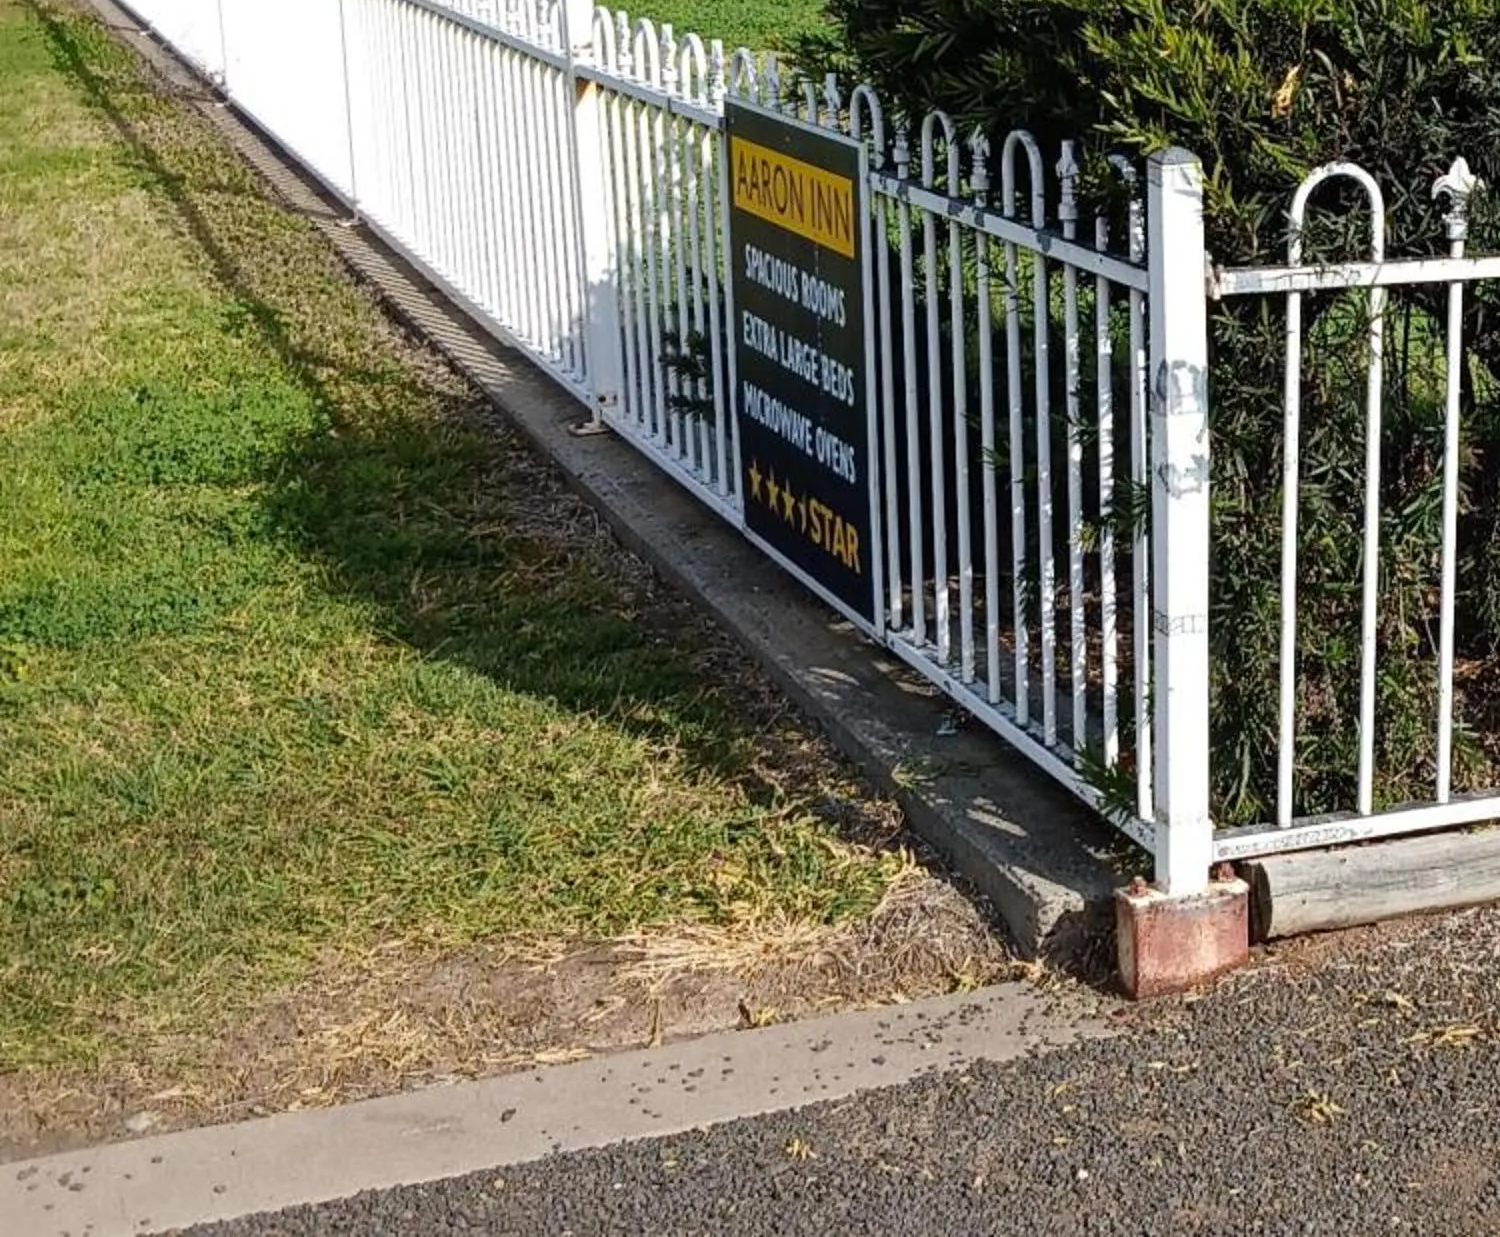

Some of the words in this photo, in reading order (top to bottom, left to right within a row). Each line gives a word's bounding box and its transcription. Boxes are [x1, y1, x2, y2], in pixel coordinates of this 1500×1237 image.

[737, 150, 804, 224] AARON
[811, 178, 850, 243] INN
[745, 243, 799, 303] SPACIOUS
[801, 270, 846, 328] ROOMS
[743, 310, 779, 362] EXTRA
[780, 330, 819, 387] LARGE
[820, 353, 855, 406] BEDS
[743, 380, 814, 457] MICROWAVE
[815, 426, 856, 484] OVENS
[809, 497, 861, 575] STAR
